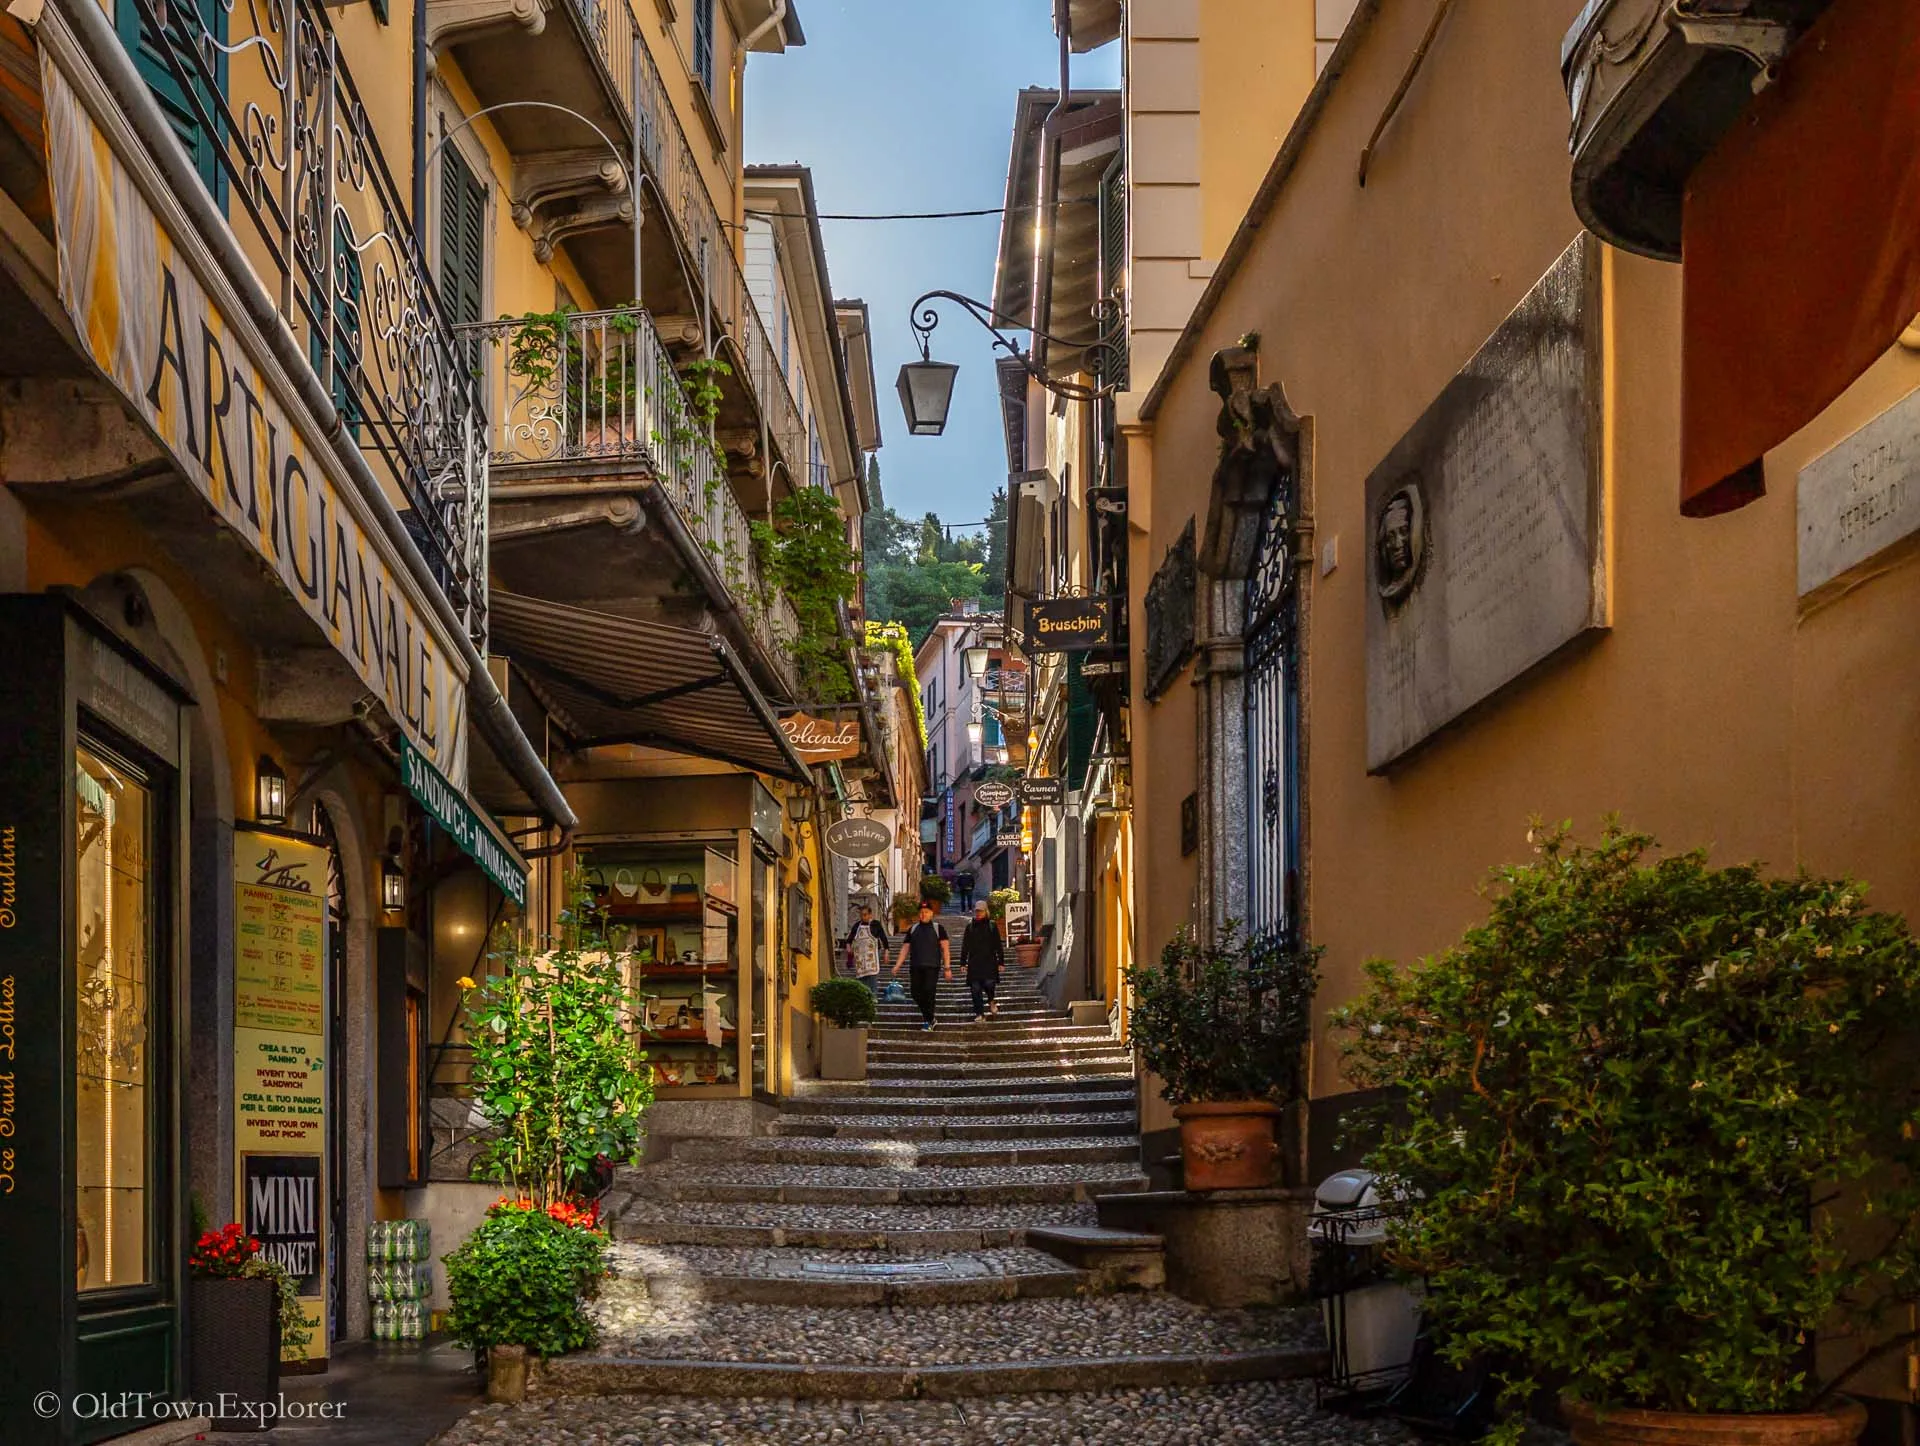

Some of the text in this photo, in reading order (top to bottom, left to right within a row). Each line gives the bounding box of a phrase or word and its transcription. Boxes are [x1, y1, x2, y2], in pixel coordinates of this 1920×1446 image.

[146, 262, 437, 748] ARTIGIANALE
[1038, 615, 1101, 633] Bruschini
[1023, 783, 1057, 793] Carmen
[406, 747, 468, 845] SANDWICH
[475, 825, 525, 905] MINIMARKET
[830, 825, 886, 844] La Lanterna
[258, 1043, 306, 1054] CREA IL TUO
[268, 1055, 297, 1064] PANINO
[256, 1069, 308, 1079] INVENT YOUR
[262, 1080, 303, 1089] SANDWICH
[242, 1093, 264, 1101] CREA
[275, 1095, 291, 1103] TUO
[293, 1096, 321, 1105] PANINO
[240, 1103, 256, 1112] PER
[258, 1104, 265, 1112] IL
[267, 1105, 286, 1113] GIRO
[297, 1106, 323, 1115] BARCA
[246, 1119, 318, 1129] INVENT YOUR OWN
[259, 1129, 306, 1138] BOAT PICNIC
[250, 1176, 316, 1235] MINI
